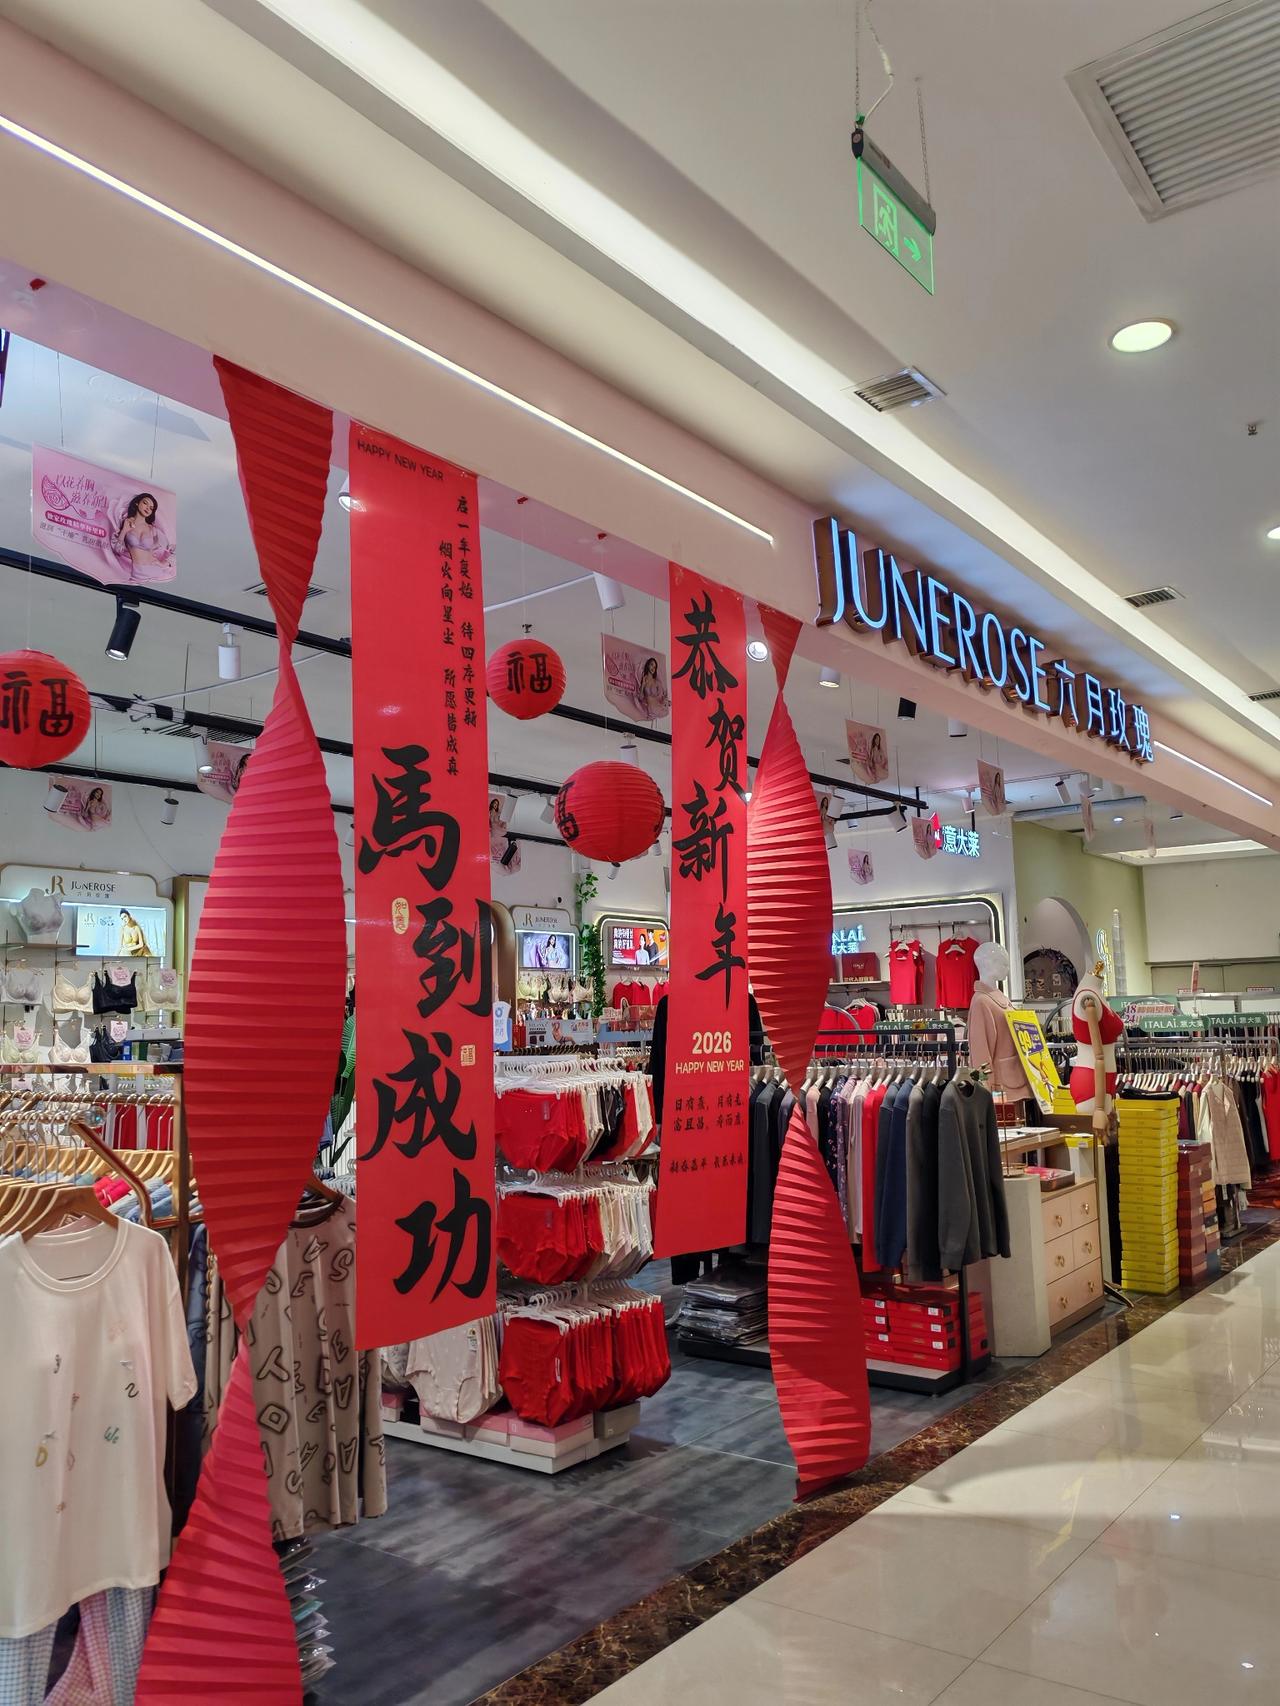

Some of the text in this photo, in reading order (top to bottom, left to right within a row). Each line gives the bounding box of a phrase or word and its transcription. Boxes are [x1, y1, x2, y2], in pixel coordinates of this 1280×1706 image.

[356, 440, 444, 482] HAPPY NEW YEAR
[830, 517, 1154, 763] JUNEROSE 六月玫瑰
[507, 651, 553, 694] 福
[0, 670, 74, 737] 福
[671, 591, 746, 1011] 恭贺新年
[692, 1031, 732, 1054] 2026
[675, 1059, 745, 1074] HAPPY NEW YEAR
